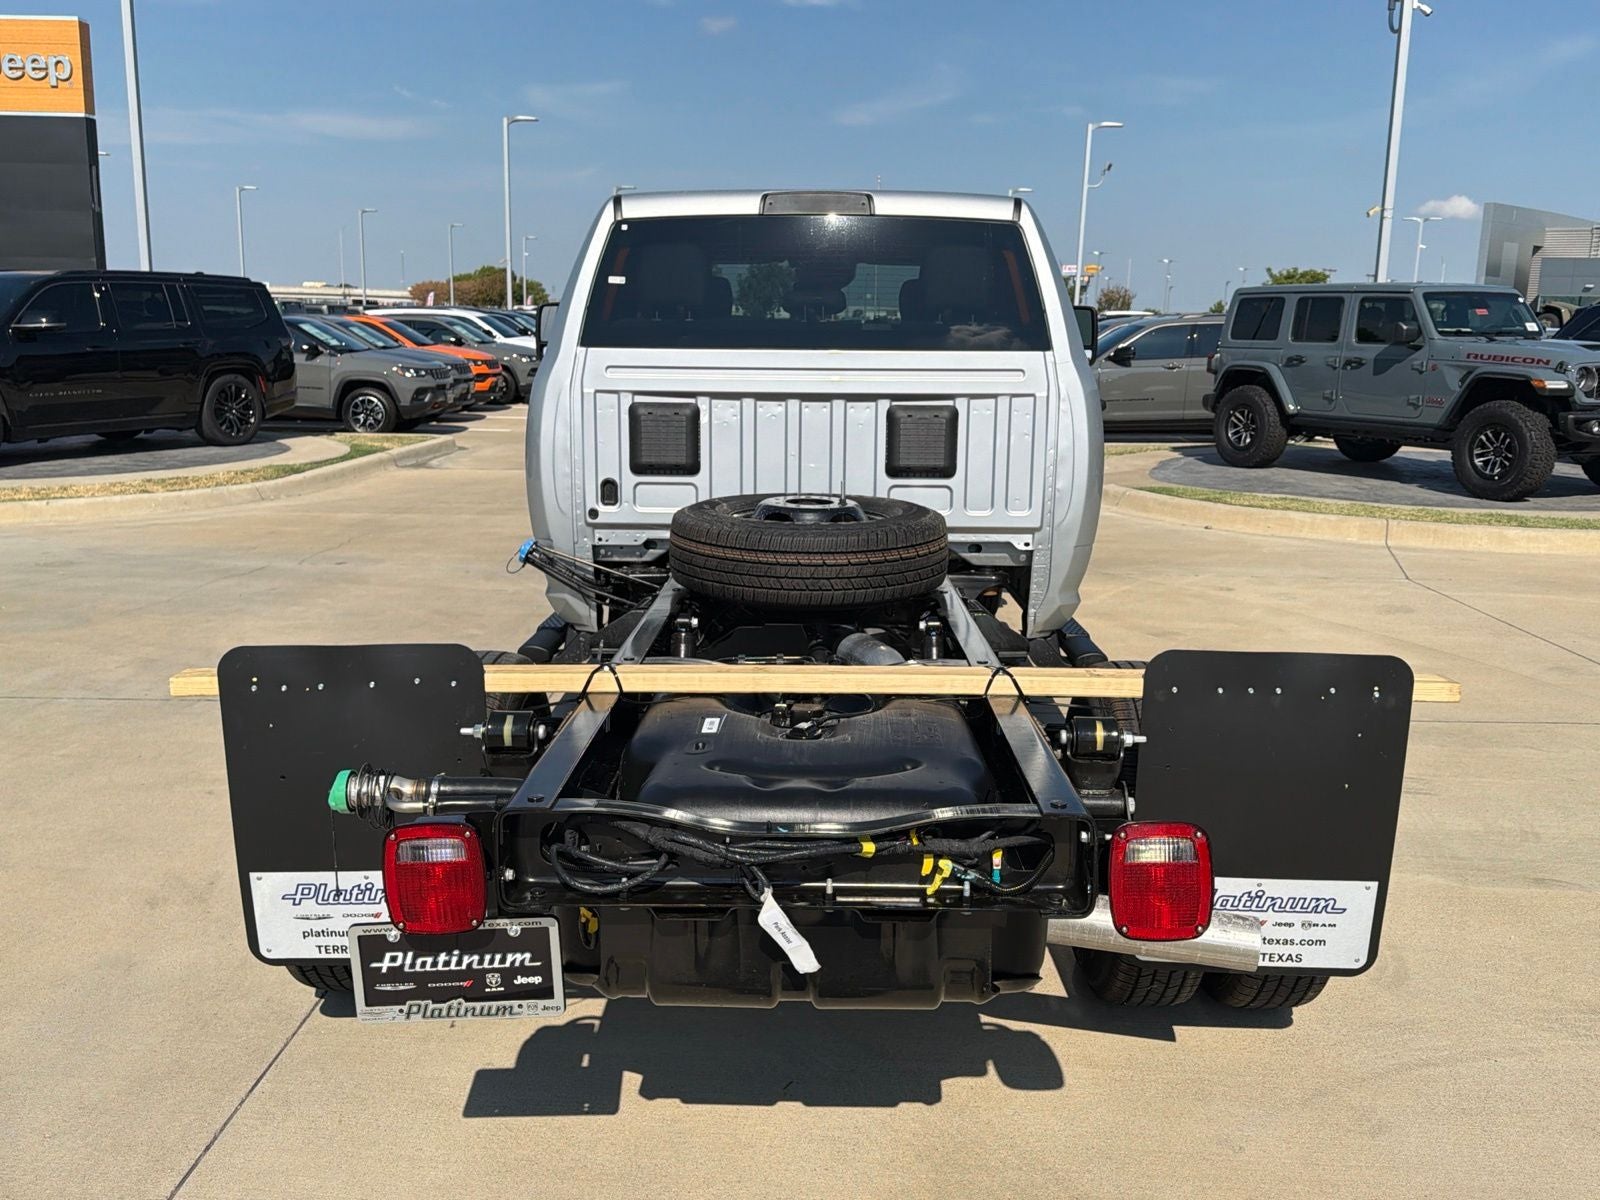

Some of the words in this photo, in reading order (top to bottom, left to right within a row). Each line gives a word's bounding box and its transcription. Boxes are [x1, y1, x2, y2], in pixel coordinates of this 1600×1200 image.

[0, 53, 72, 87] eep
[1466, 353, 1551, 365] RUBICON
[1272, 921, 1295, 929] Jeep
[1261, 936, 1326, 947] texas.com
[369, 949, 542, 973] Platinum
[1259, 952, 1303, 963] TEXAS
[513, 975, 543, 985] Jeep
[405, 1000, 524, 1020] Platinum
[541, 1004, 561, 1012] Jeep
